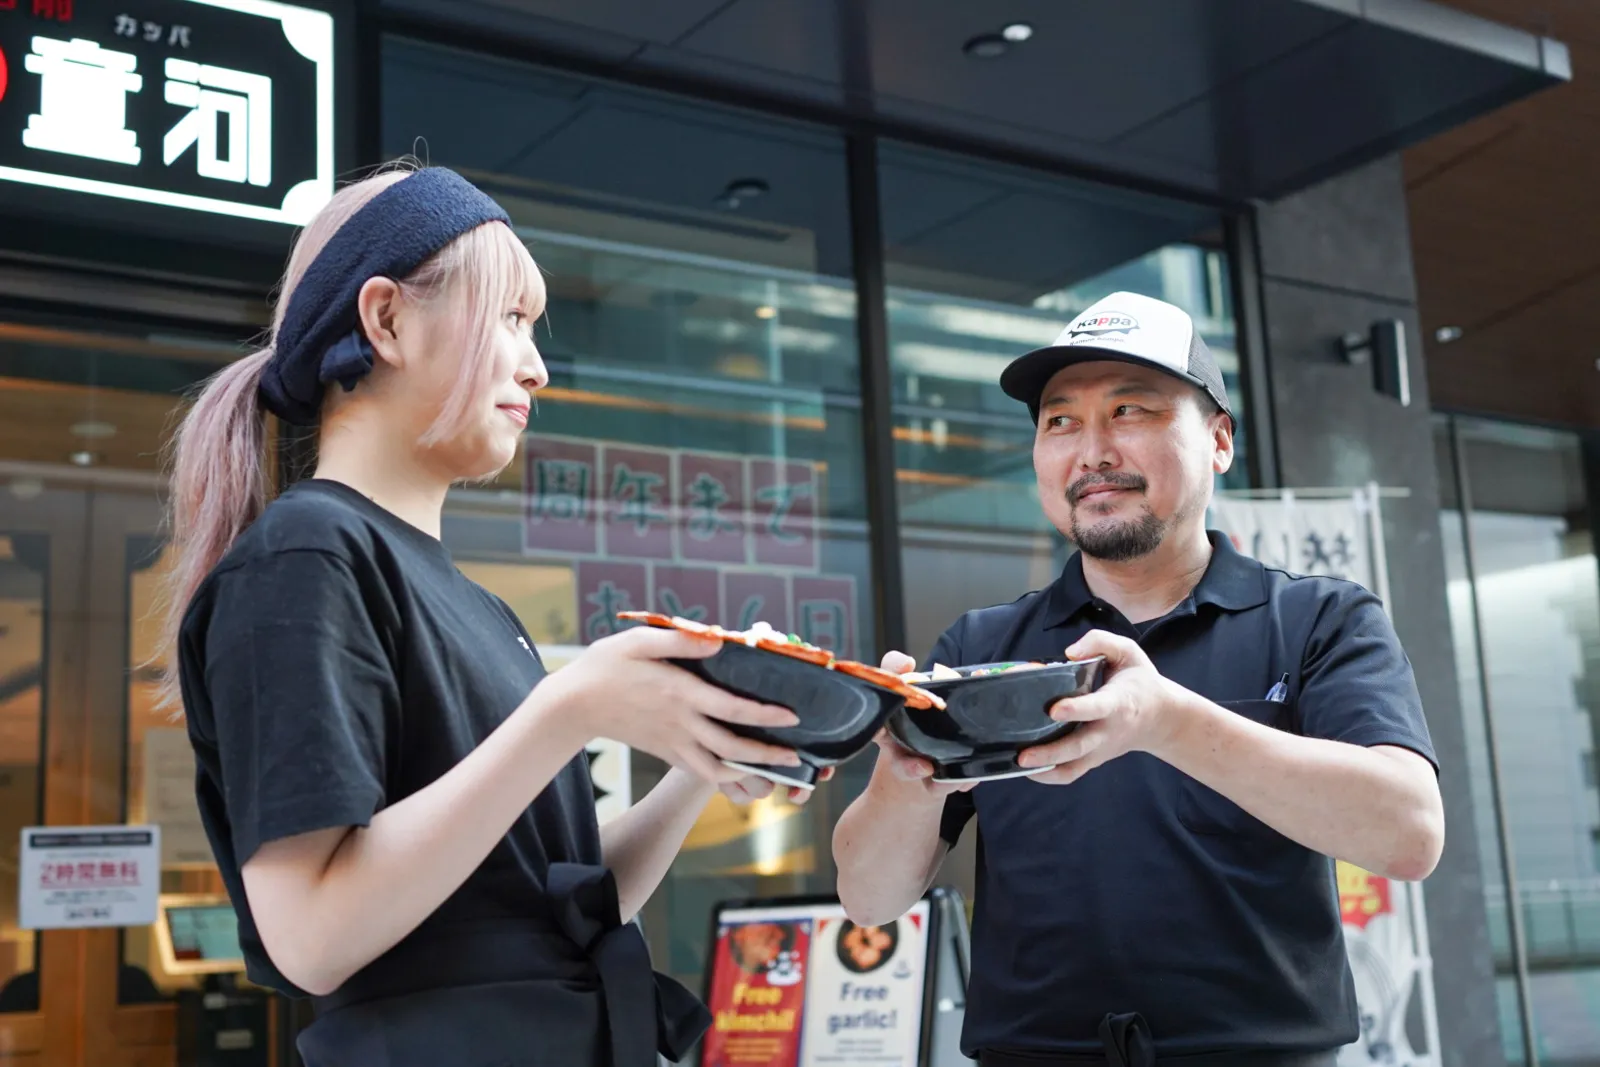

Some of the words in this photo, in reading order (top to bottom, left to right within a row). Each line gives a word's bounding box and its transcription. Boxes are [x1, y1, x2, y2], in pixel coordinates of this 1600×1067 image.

[114, 13, 191, 48] カッパ
[531, 459, 815, 545] 周年まで
[733, 983, 783, 1005] Free
[840, 981, 889, 1002] Free
[827, 1010, 898, 1034] garlic!
